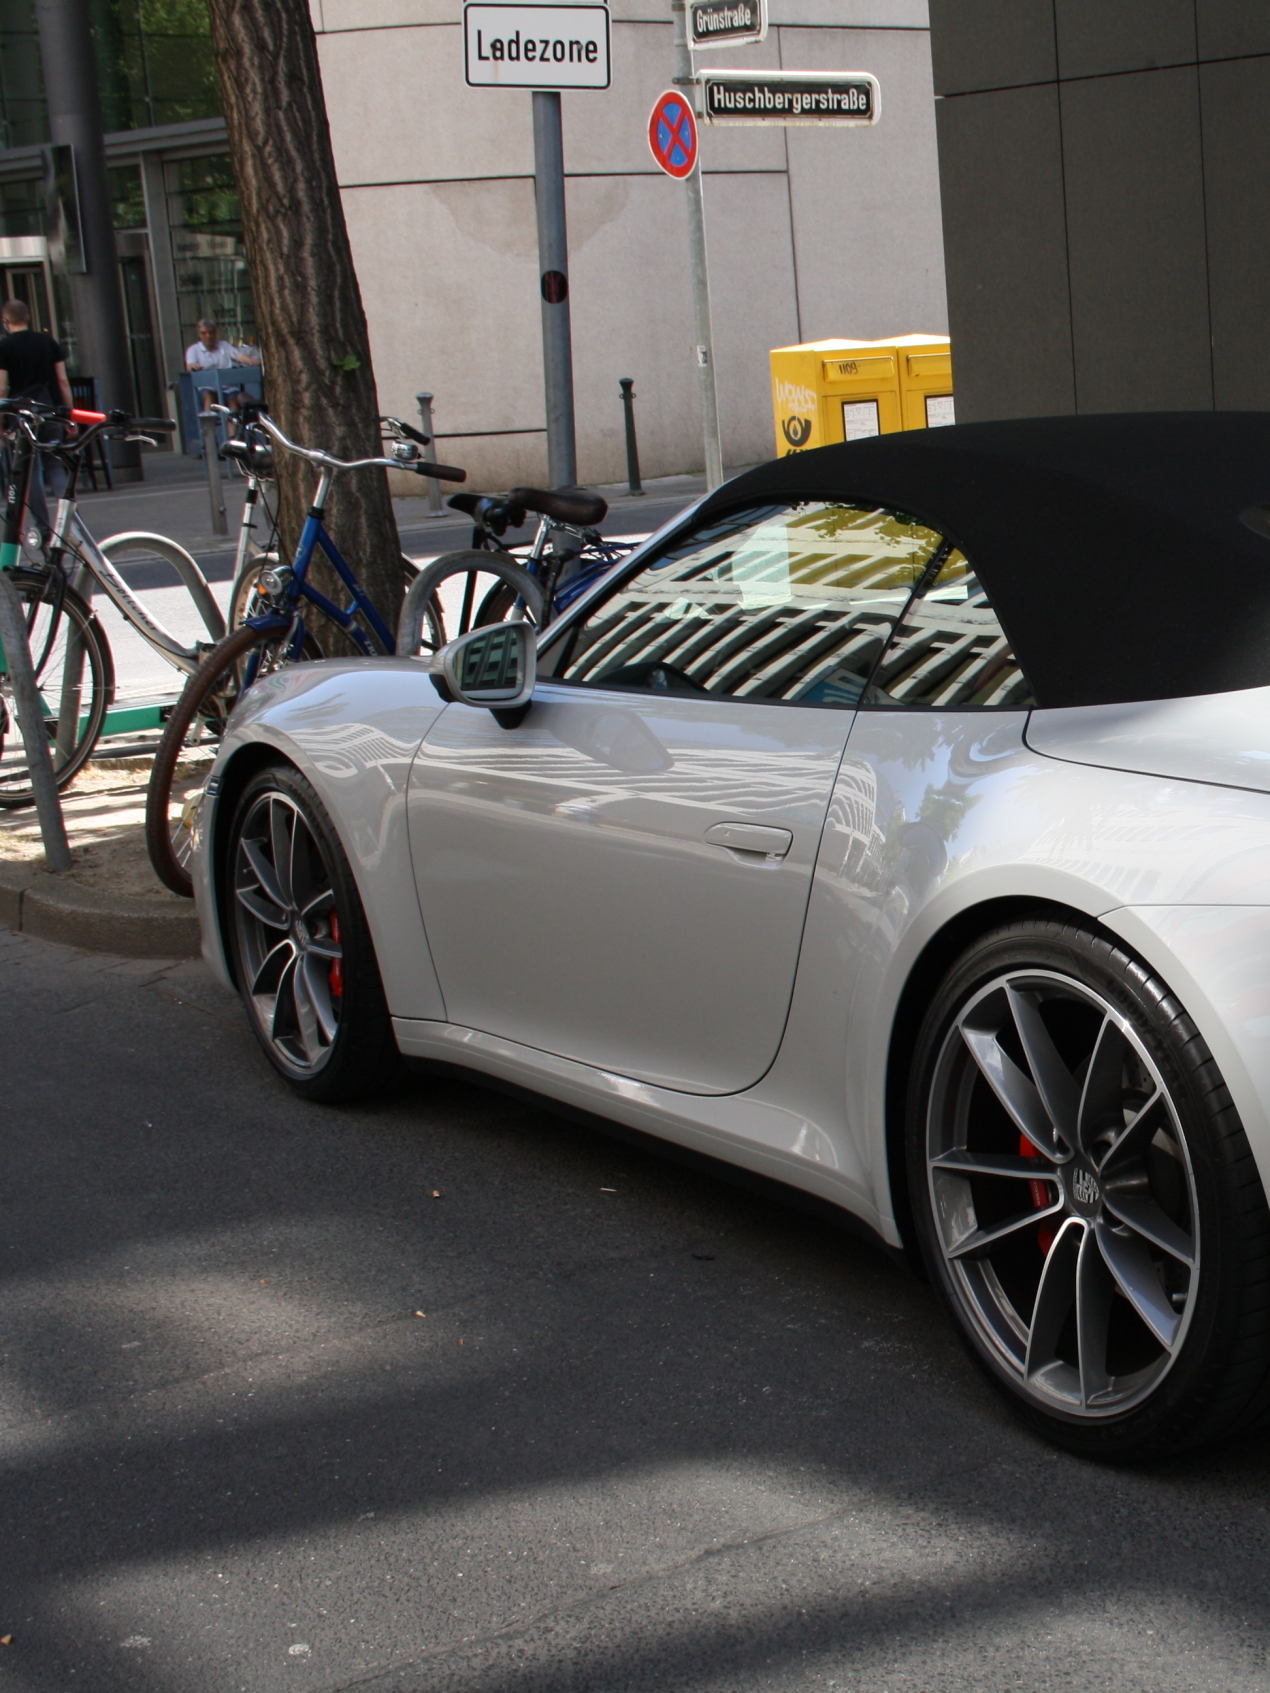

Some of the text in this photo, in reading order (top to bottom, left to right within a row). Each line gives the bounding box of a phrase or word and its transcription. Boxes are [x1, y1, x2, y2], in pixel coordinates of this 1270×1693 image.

[696, 5, 752, 34] Grünstraße
[476, 29, 599, 64] Ladezone
[713, 86, 868, 114] Huschbergerstraße
